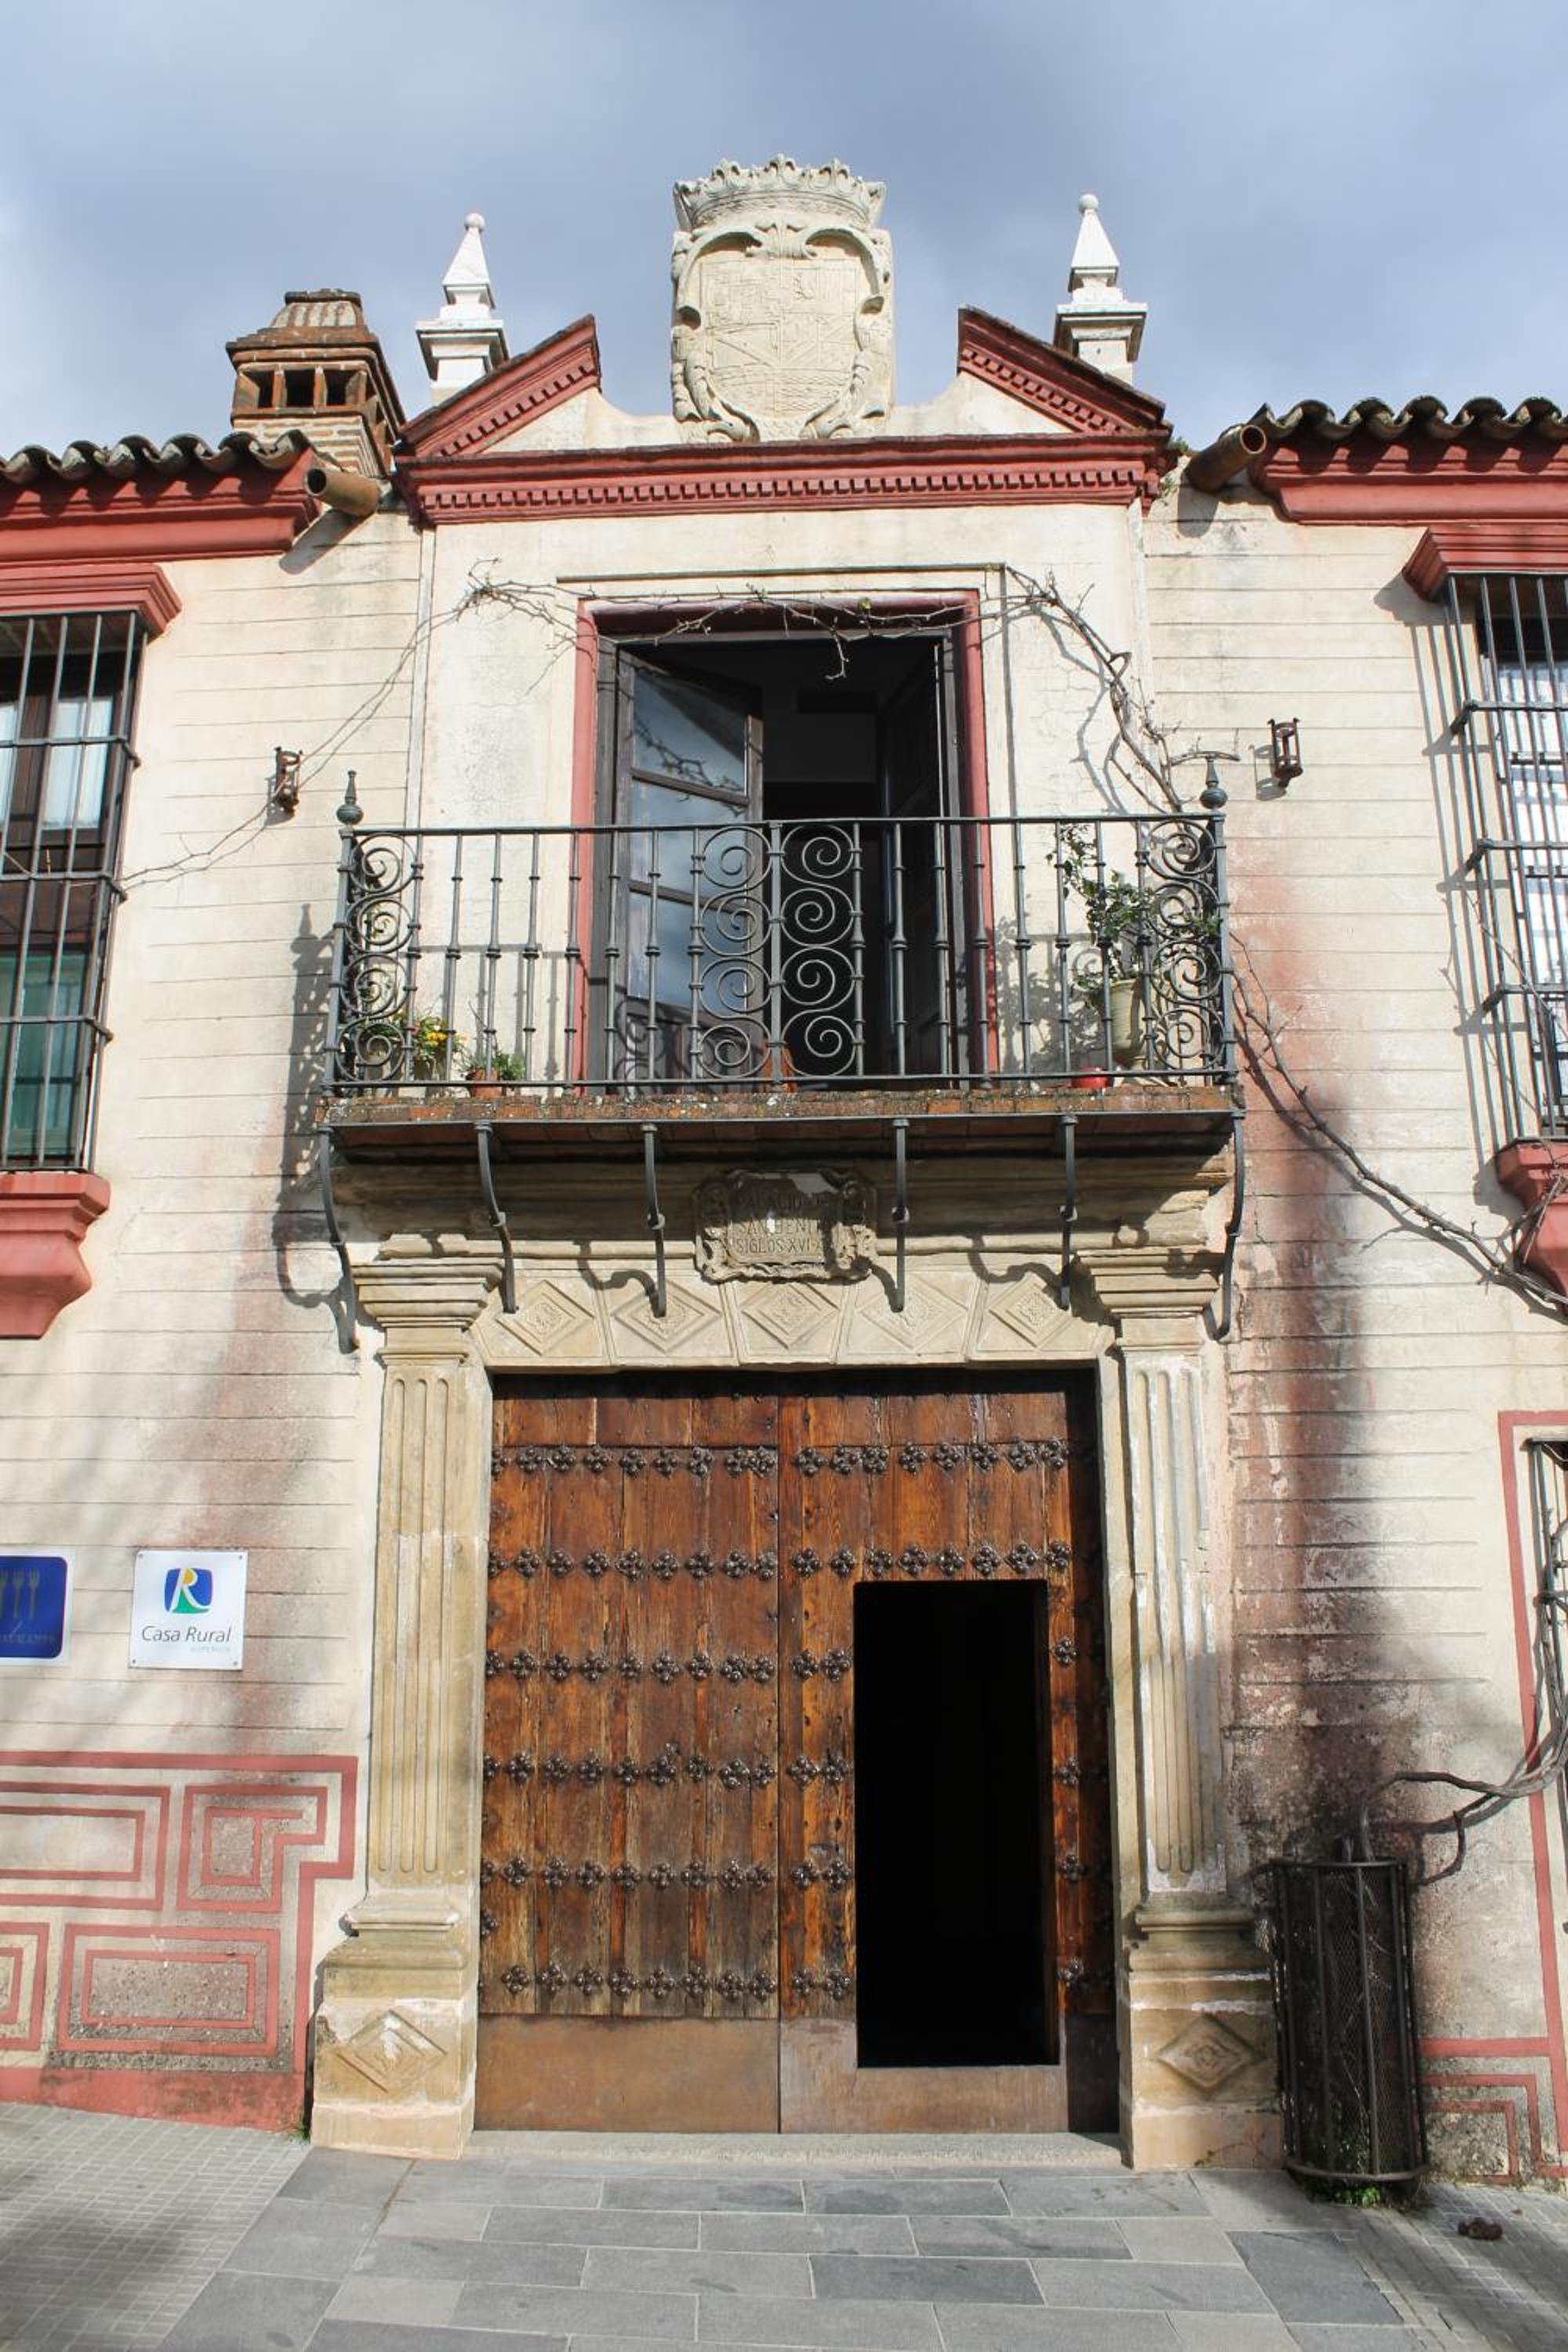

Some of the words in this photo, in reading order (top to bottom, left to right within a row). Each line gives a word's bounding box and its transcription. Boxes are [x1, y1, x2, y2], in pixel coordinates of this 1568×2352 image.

[737, 1239, 784, 1254] SIGLOS
[141, 1625, 181, 1642] Casa
[185, 1625, 232, 1643] Rural
